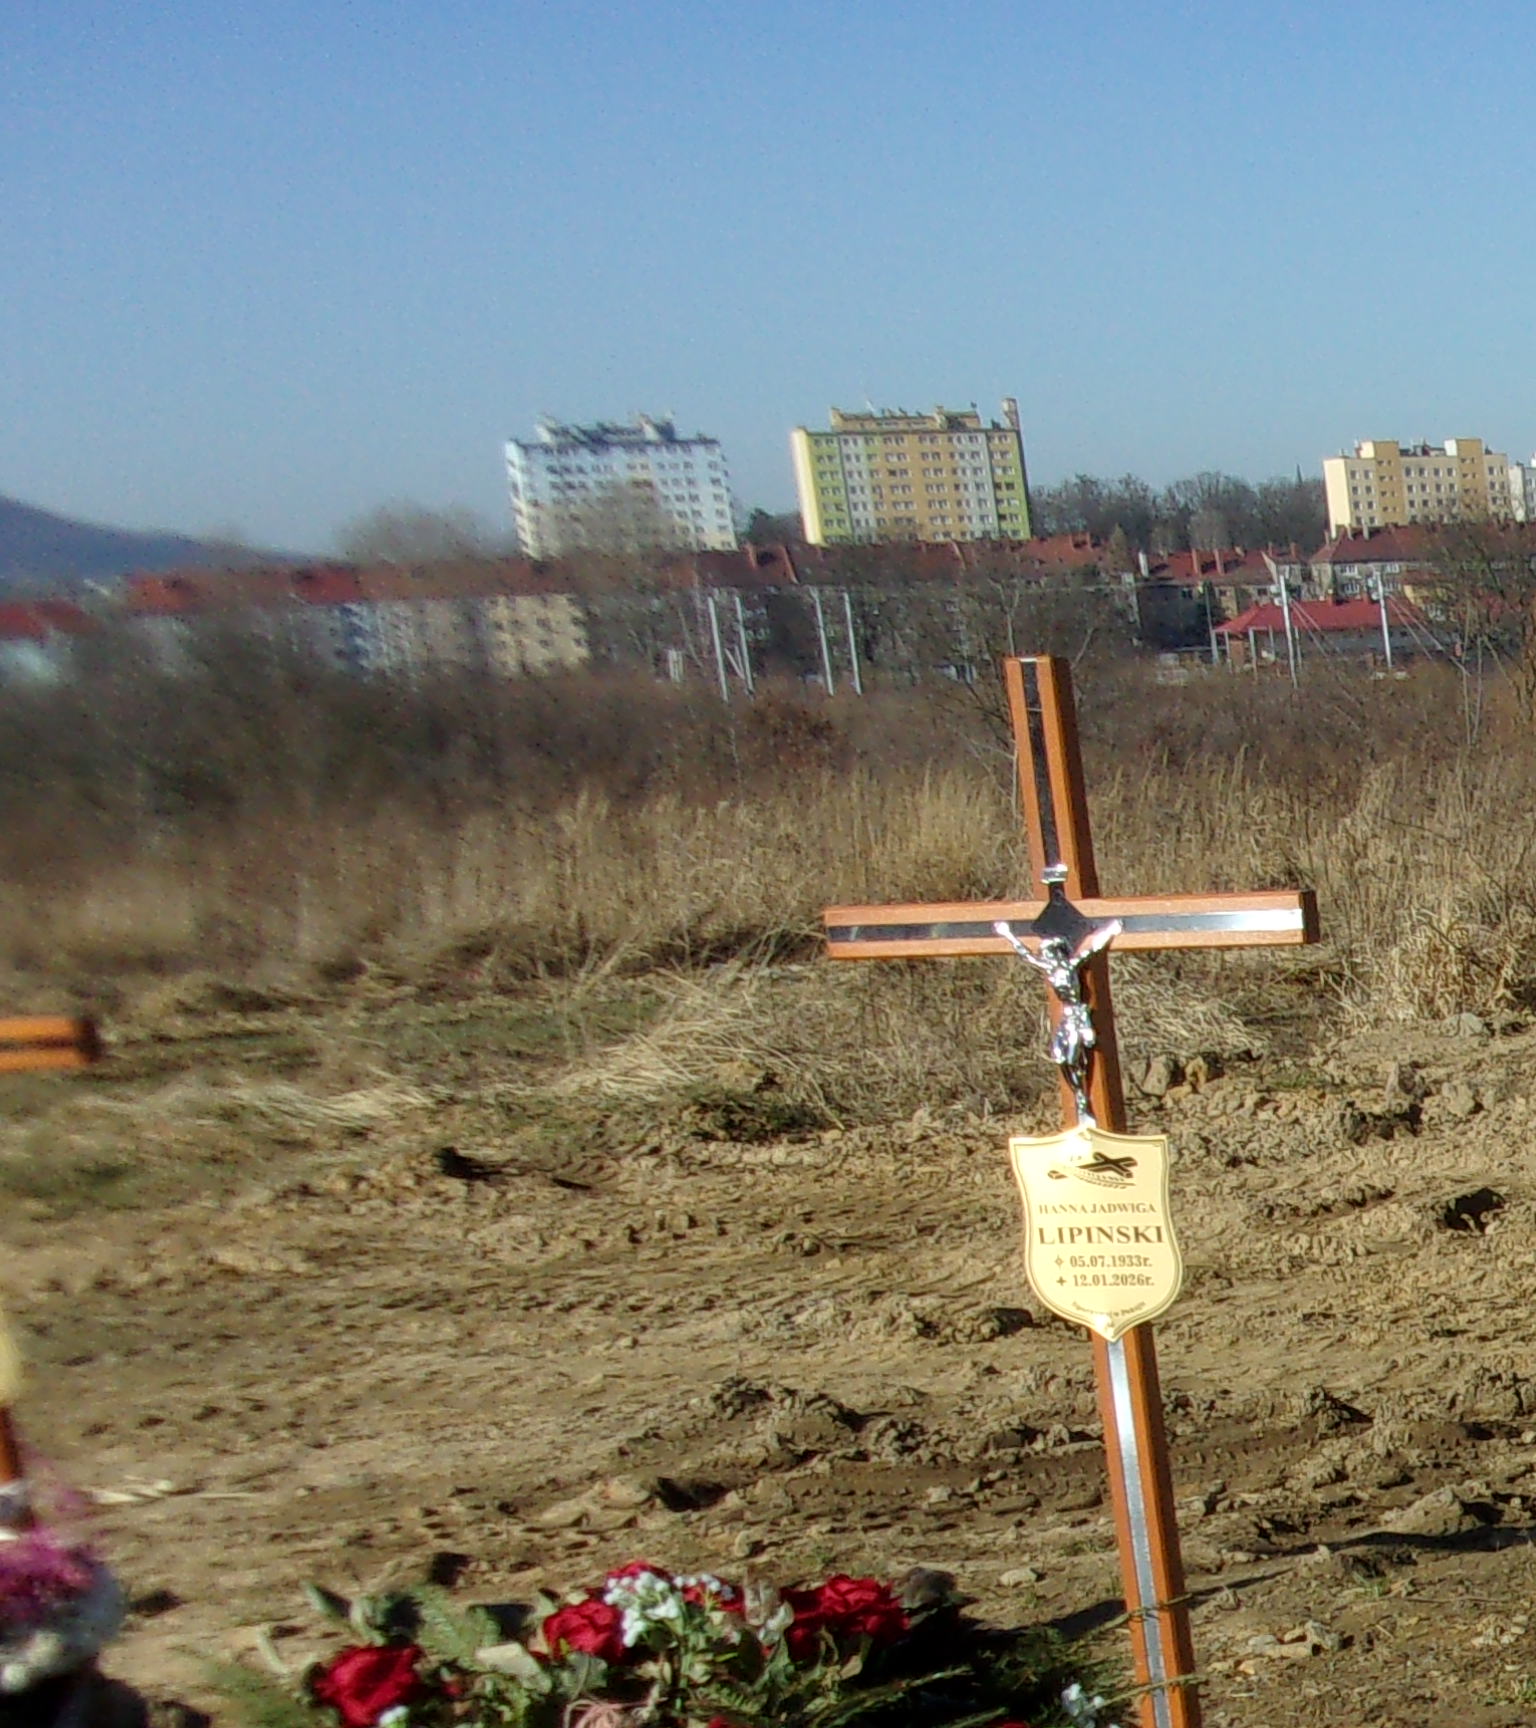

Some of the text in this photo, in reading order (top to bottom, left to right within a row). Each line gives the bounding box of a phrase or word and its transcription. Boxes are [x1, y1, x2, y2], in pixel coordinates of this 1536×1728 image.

[1038, 1202, 1158, 1215] HANNA JADWIGA
[1072, 1274, 1155, 1287] 12.01.2026r.
